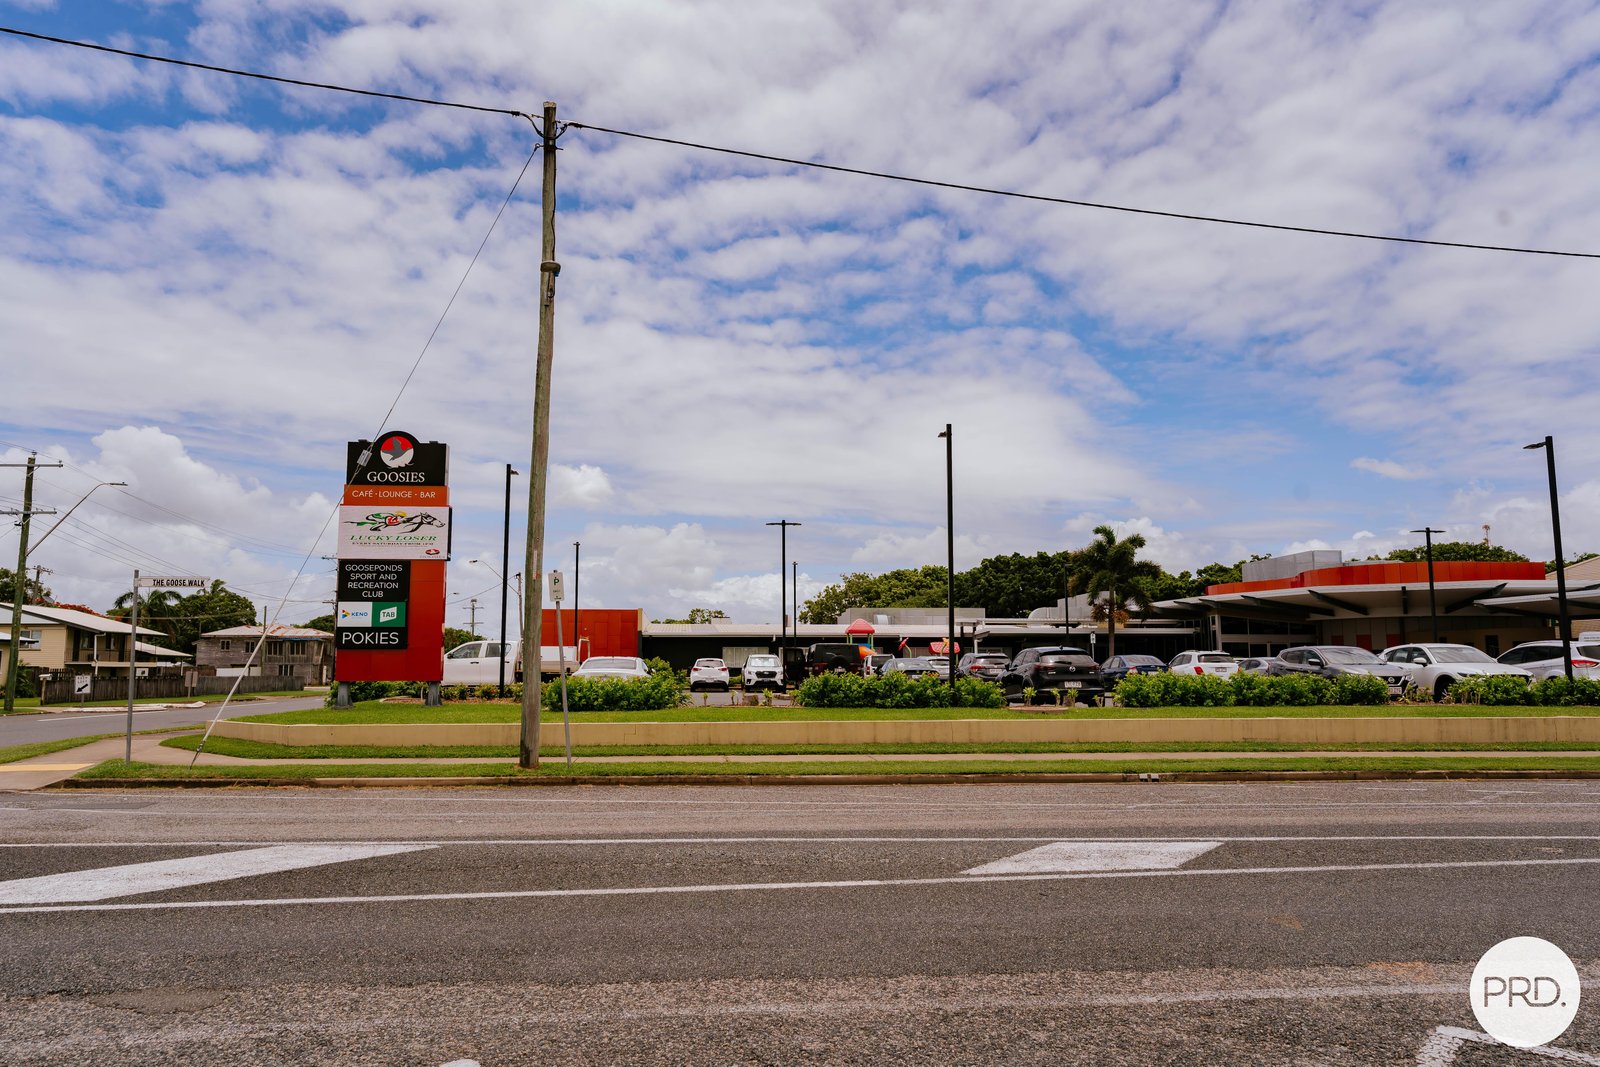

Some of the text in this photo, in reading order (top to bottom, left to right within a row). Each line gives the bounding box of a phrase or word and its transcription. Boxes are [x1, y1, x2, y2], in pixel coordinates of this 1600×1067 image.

[367, 471, 425, 483] GOOSIES
[352, 489, 373, 498] CAFÉ
[379, 490, 413, 498] LOUNGE
[345, 564, 403, 572] GOOSEPONDS
[153, 579, 205, 587] THE GOOSE WALK
[342, 632, 399, 645] POKIES
